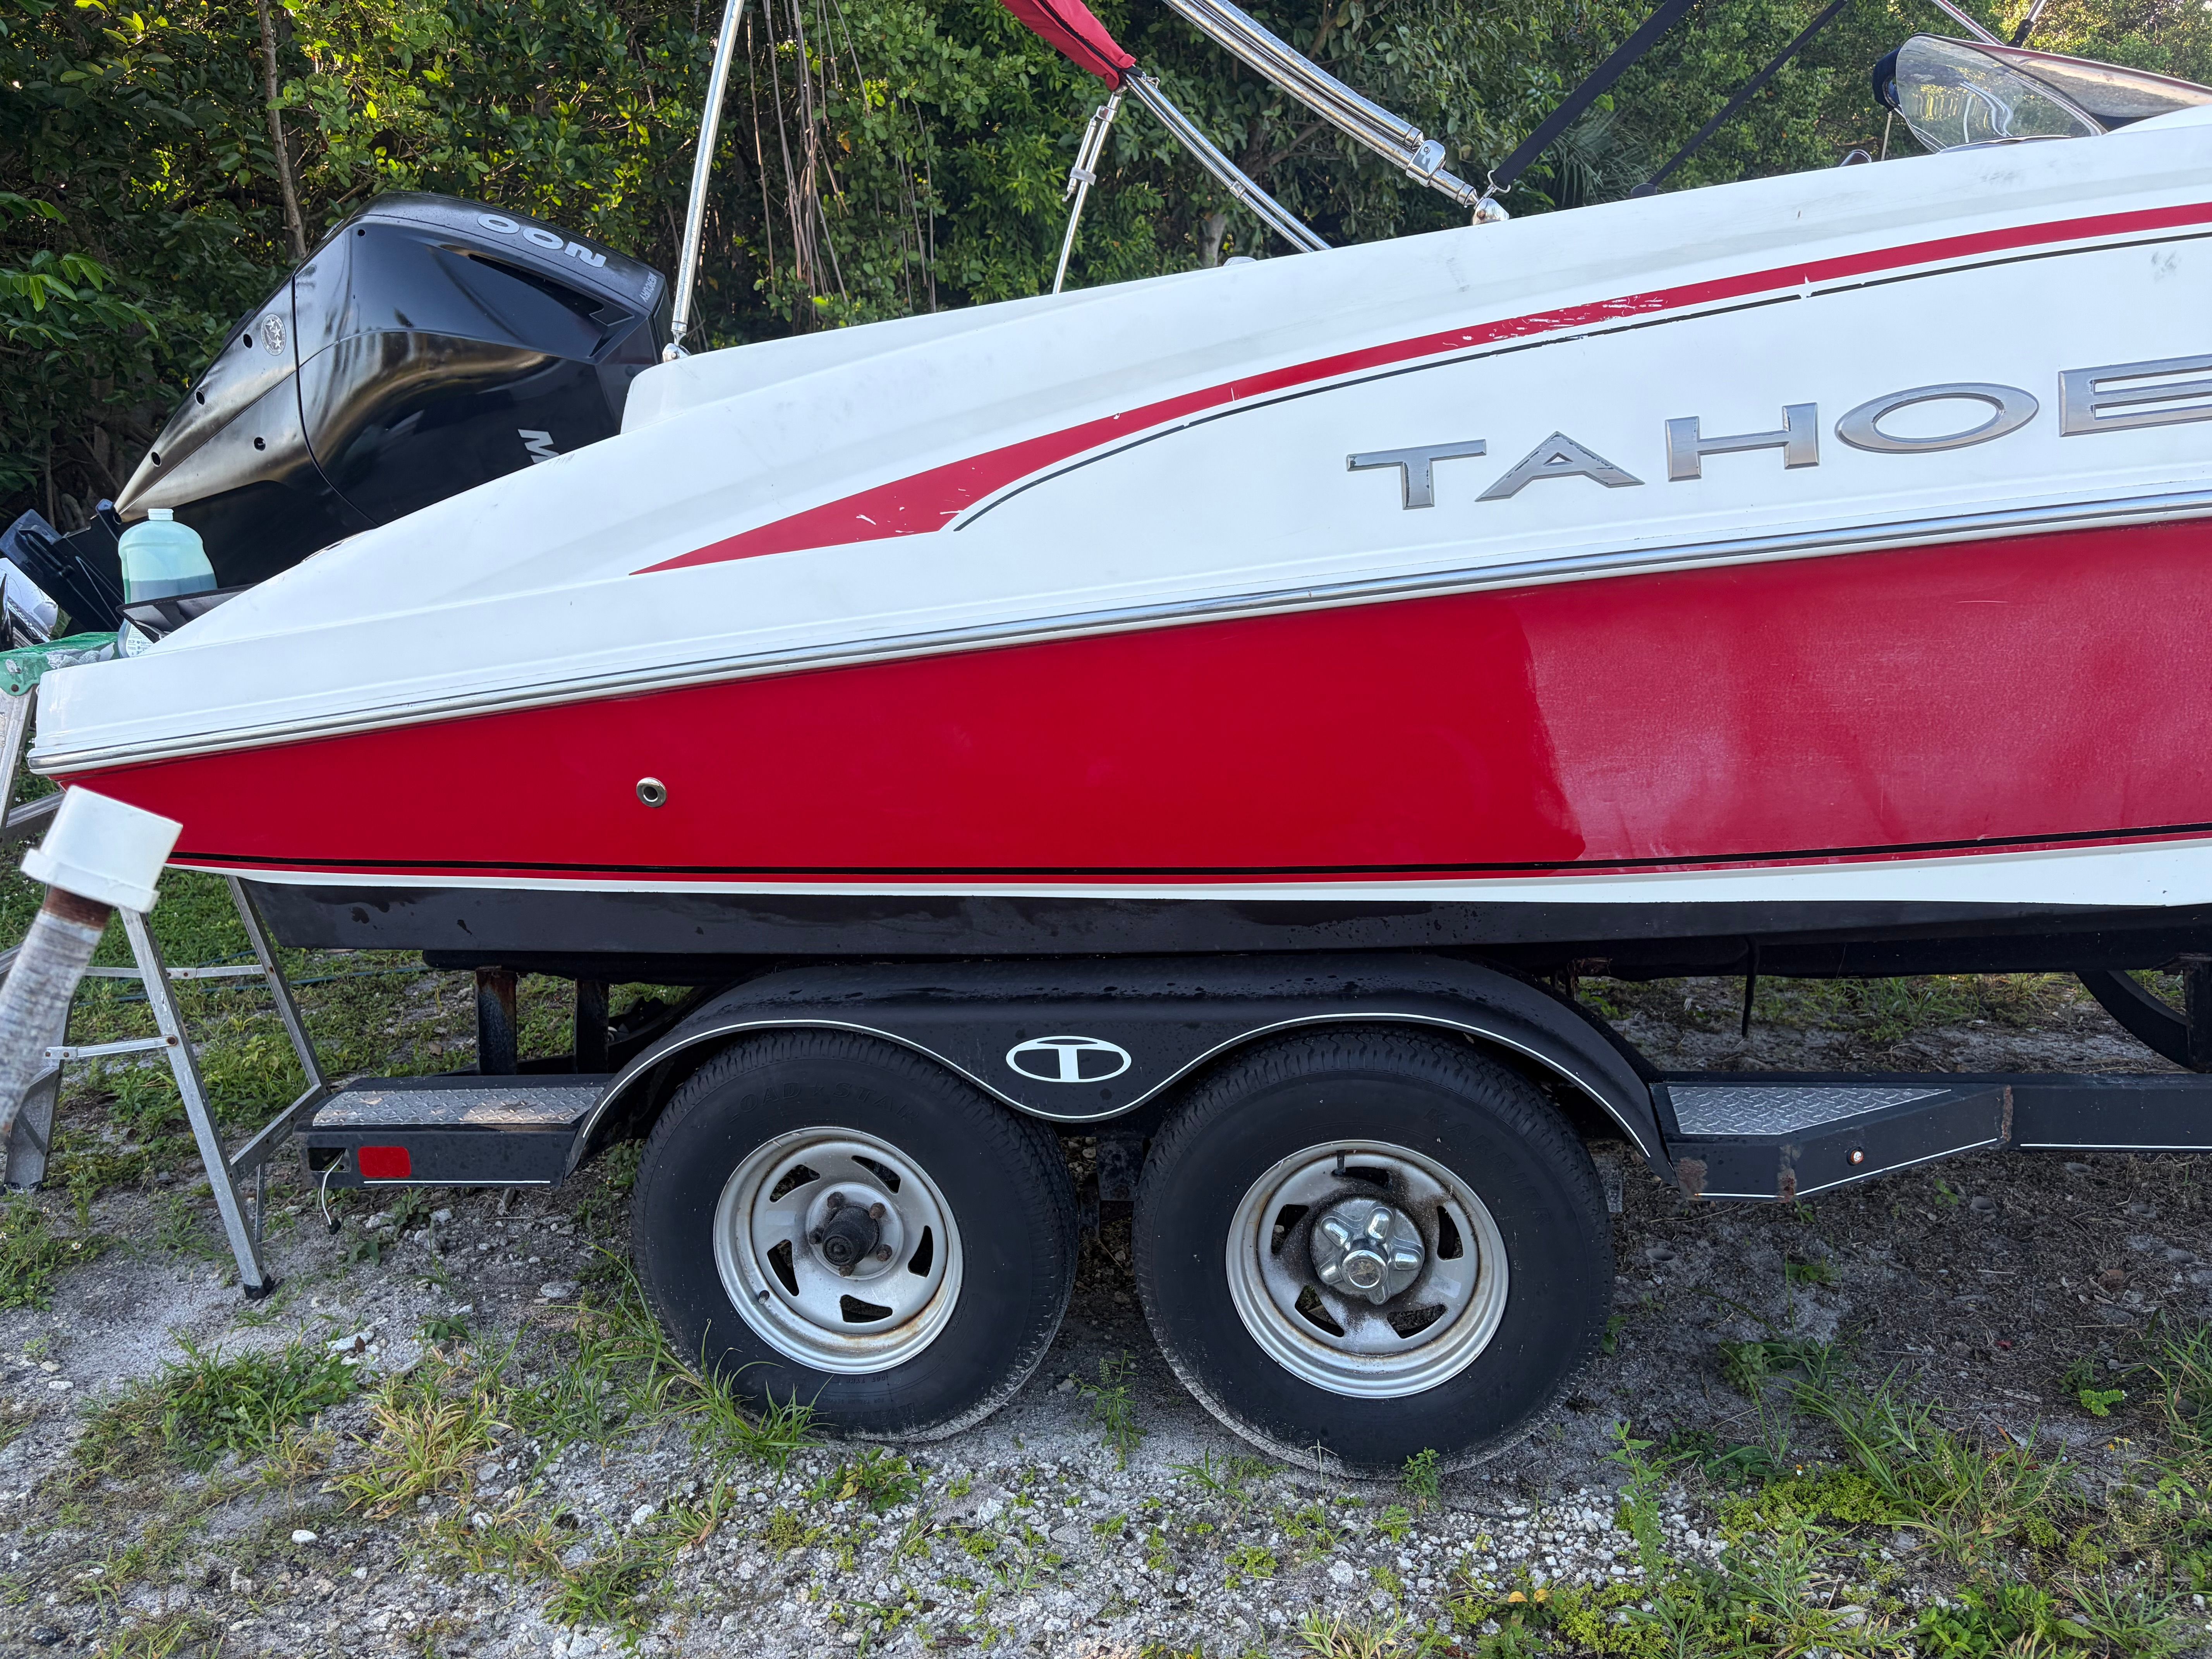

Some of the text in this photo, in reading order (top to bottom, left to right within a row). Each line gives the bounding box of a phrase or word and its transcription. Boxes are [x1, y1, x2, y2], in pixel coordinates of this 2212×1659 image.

[477, 213, 606, 268] 200
[640, 272, 657, 303] MERCURY
[1345, 354, 2212, 510] TAHOE
[723, 1081, 919, 1125] LOAD STAR
[1422, 1108, 1554, 1225] KARRIER
